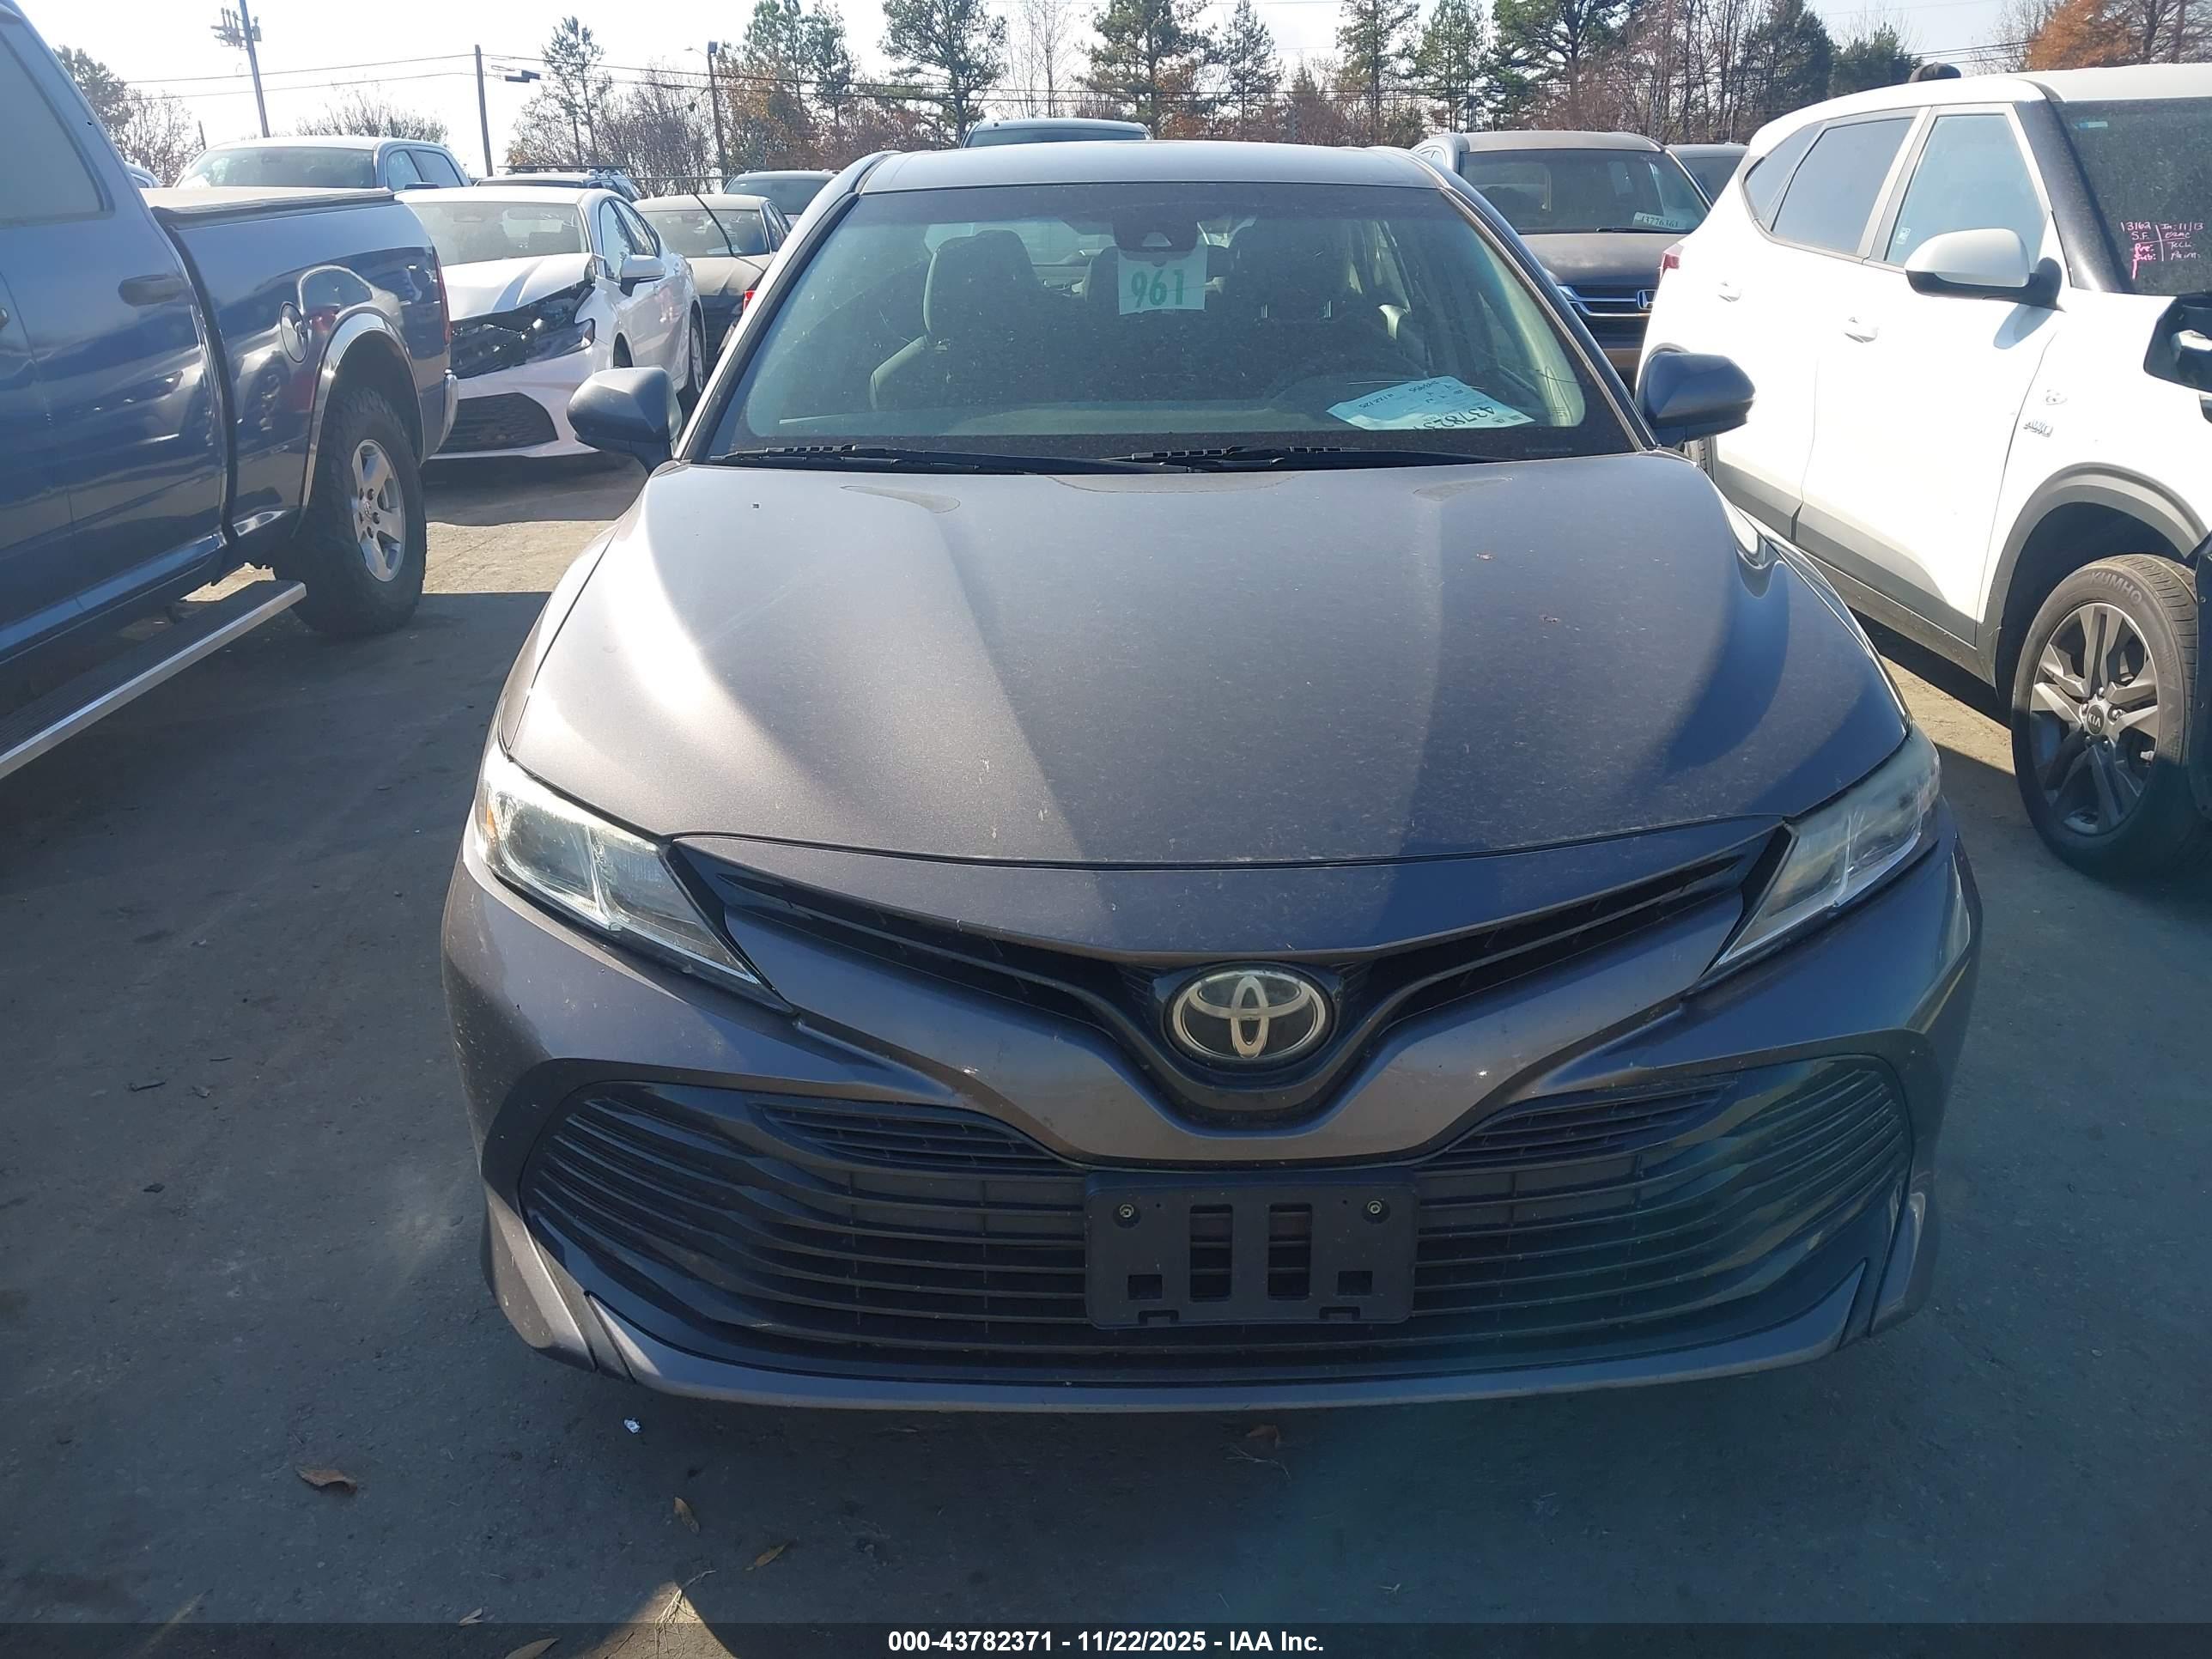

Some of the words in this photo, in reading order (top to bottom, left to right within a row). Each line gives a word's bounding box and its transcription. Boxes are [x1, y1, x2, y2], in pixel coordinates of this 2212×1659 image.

[1131, 269, 1184, 307] 961
[2089, 571, 2142, 605] KUMHO
[2087, 713, 2101, 728] KIA
